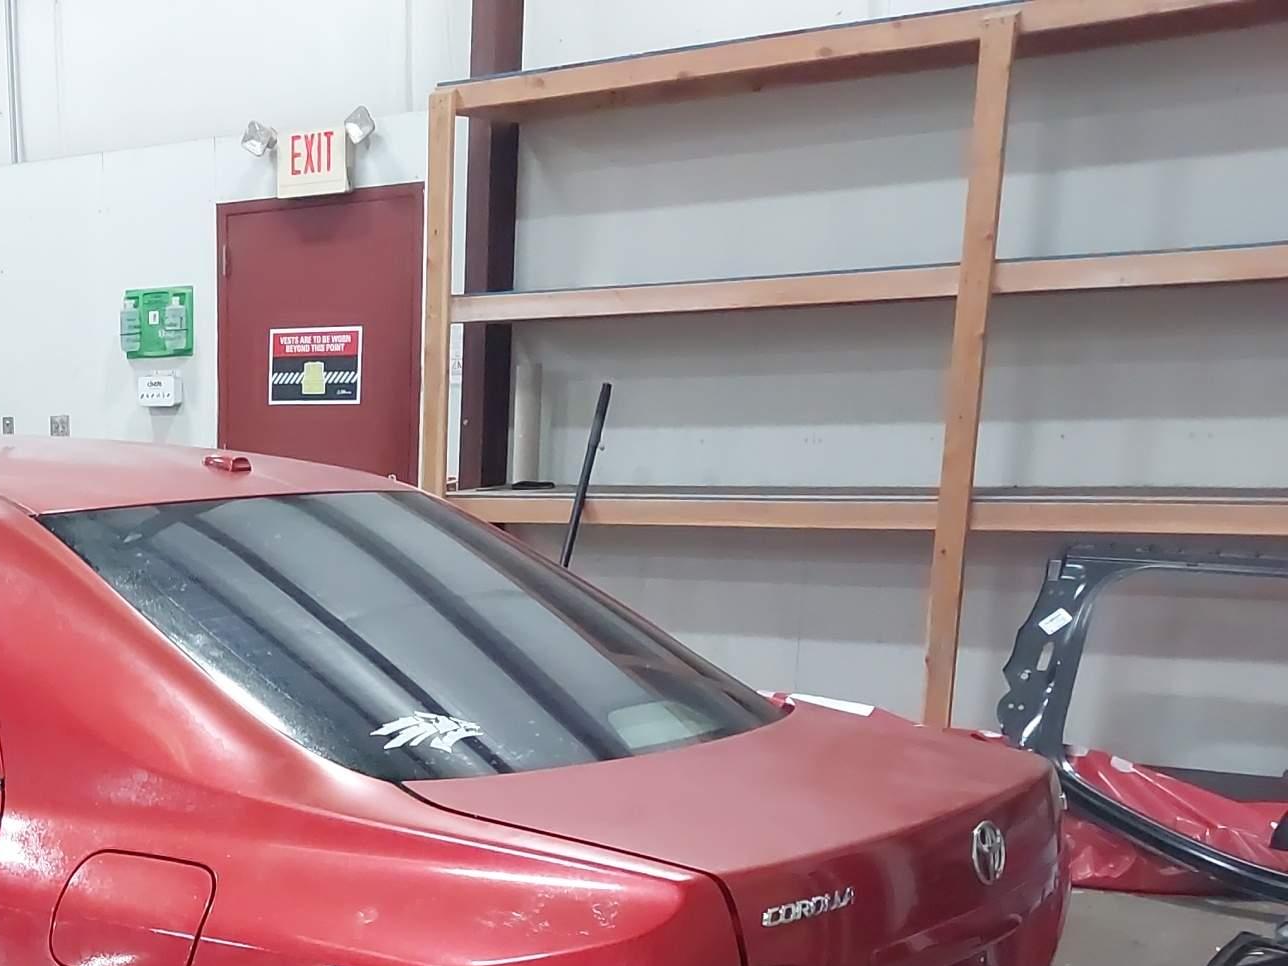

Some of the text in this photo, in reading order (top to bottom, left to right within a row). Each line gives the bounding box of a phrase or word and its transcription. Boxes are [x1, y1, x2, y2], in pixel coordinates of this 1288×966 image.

[291, 131, 334, 176] EXIT
[280, 335, 351, 345] VESTS ARE TO BE WORN
[285, 343, 345, 353] BEYOND THIS POINT
[762, 887, 854, 927] COROLLA
